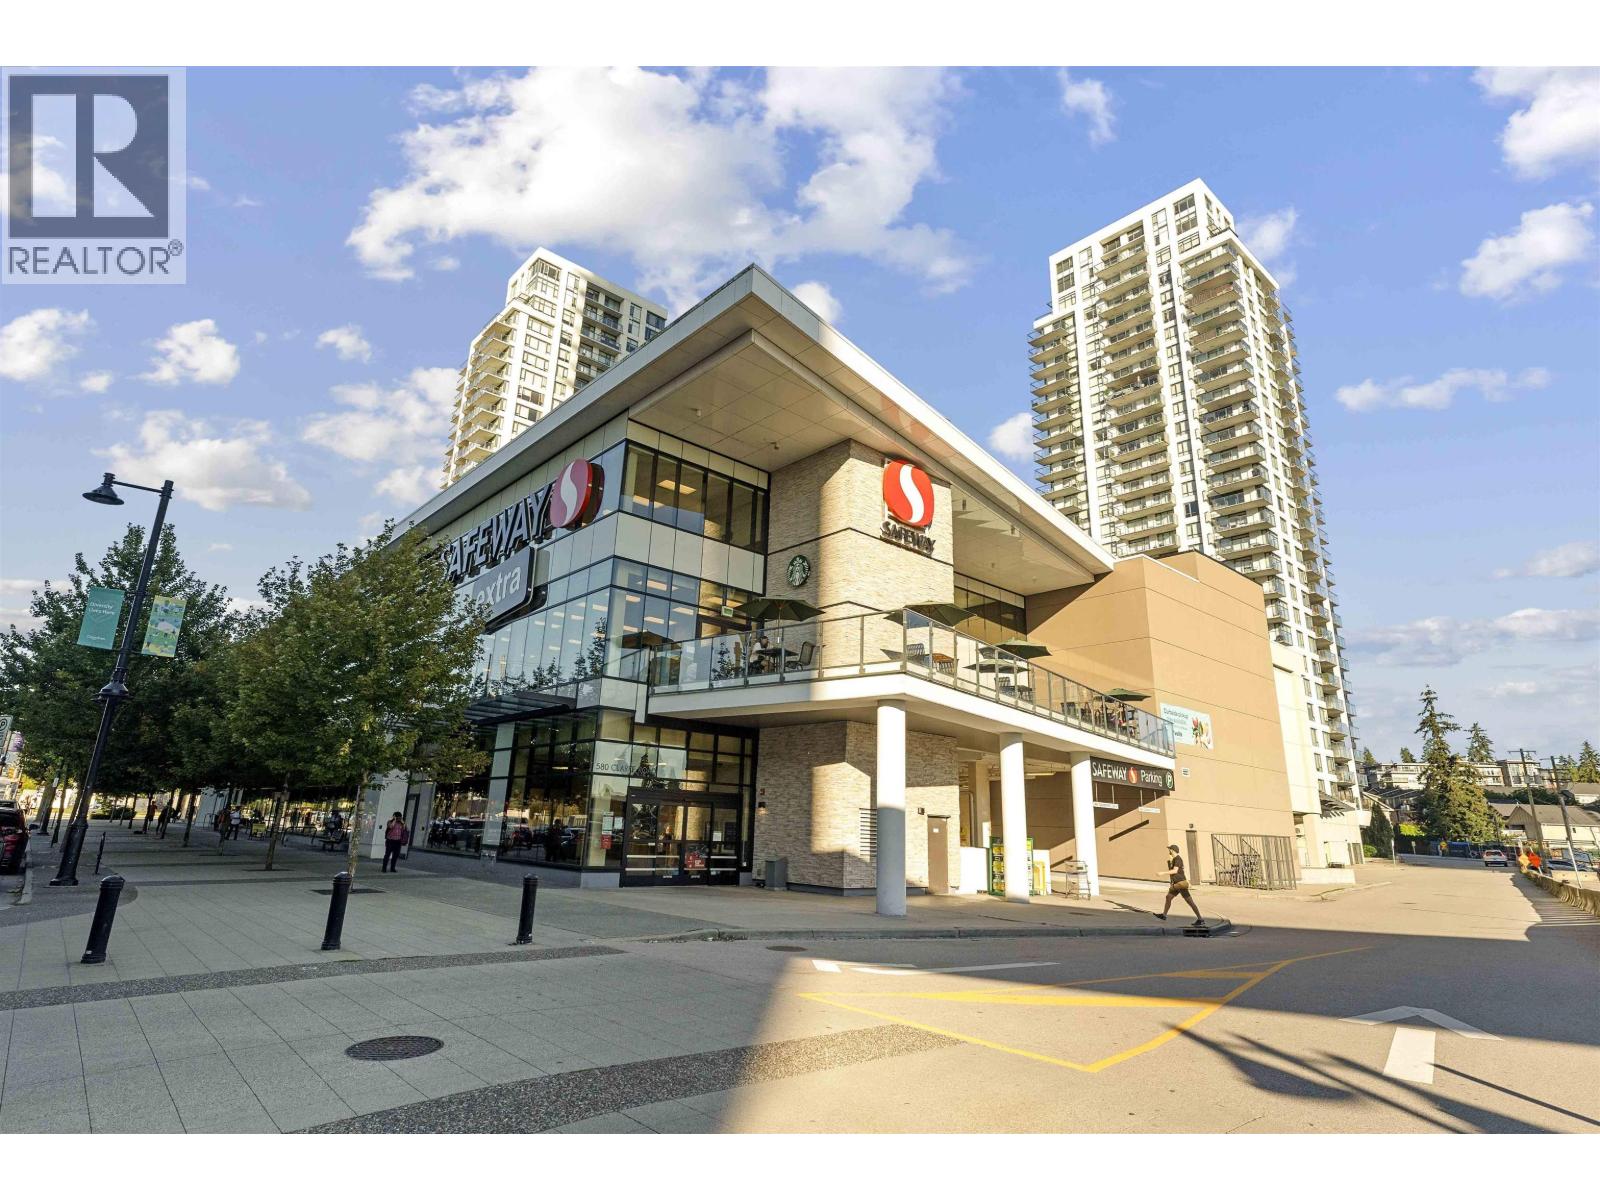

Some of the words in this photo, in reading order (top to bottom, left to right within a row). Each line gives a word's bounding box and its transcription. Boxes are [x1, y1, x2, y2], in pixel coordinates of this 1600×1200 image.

[881, 520, 936, 555] SAFEWAY
[476, 566, 521, 605] extra
[1092, 761, 1127, 781] SAFEWAY
[1140, 769, 1163, 787] Parking
